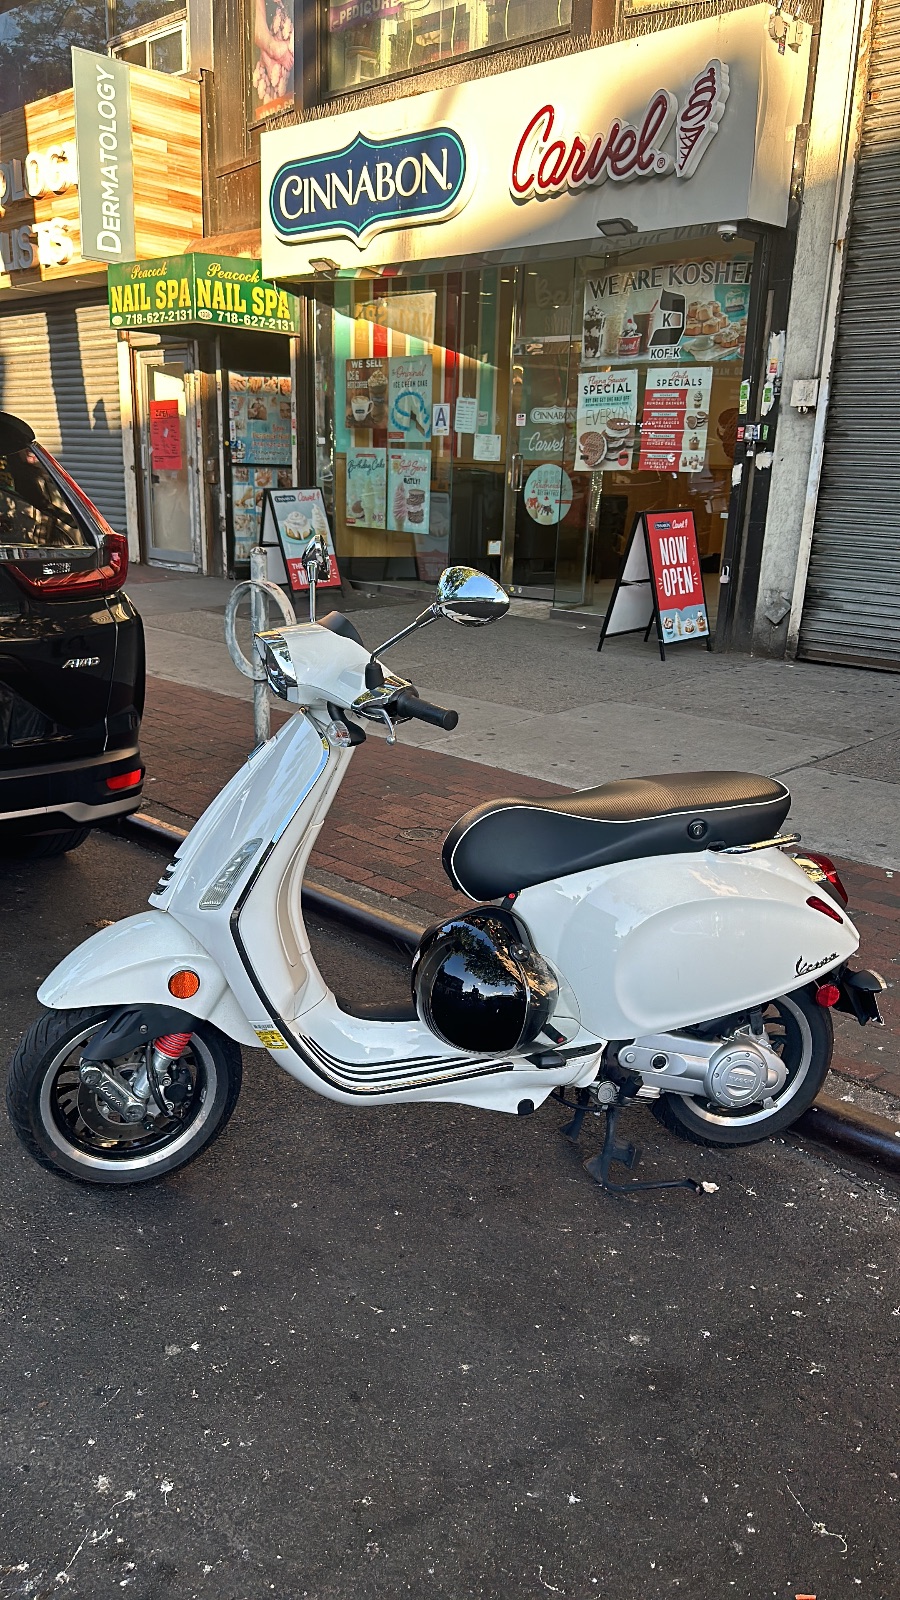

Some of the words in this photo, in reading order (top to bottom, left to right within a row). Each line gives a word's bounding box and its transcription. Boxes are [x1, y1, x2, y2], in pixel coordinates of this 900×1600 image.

[512, 94, 667, 192] Carvel
[96, 64, 122, 254] DERMATOLOGY
[0, 217, 73, 272] LISTS
[130, 262, 168, 279] Peacock
[207, 263, 260, 283] Peacock
[589, 274, 620, 299] WE
[622, 267, 663, 291] ARE
[111, 283, 151, 313] NAIL
[155, 278, 191, 309] SPA
[197, 278, 246, 313] NAIL
[252, 286, 291, 319] SPA
[126, 309, 192, 325] 718-627-2131
[217, 310, 295, 332] 718-627-2131
[662, 312, 672, 328] K
[650, 347, 681, 359] KOF-K
[351, 360, 363, 369] WE
[366, 359, 383, 368] SELL
[583, 383, 632, 395] SPECIAL
[656, 378, 702, 387] SPECIALS
[435, 407, 446, 426] A
[585, 406, 635, 426] EVERYDAY
[658, 535, 688, 566] NOW
[662, 566, 694, 597] OPEN
